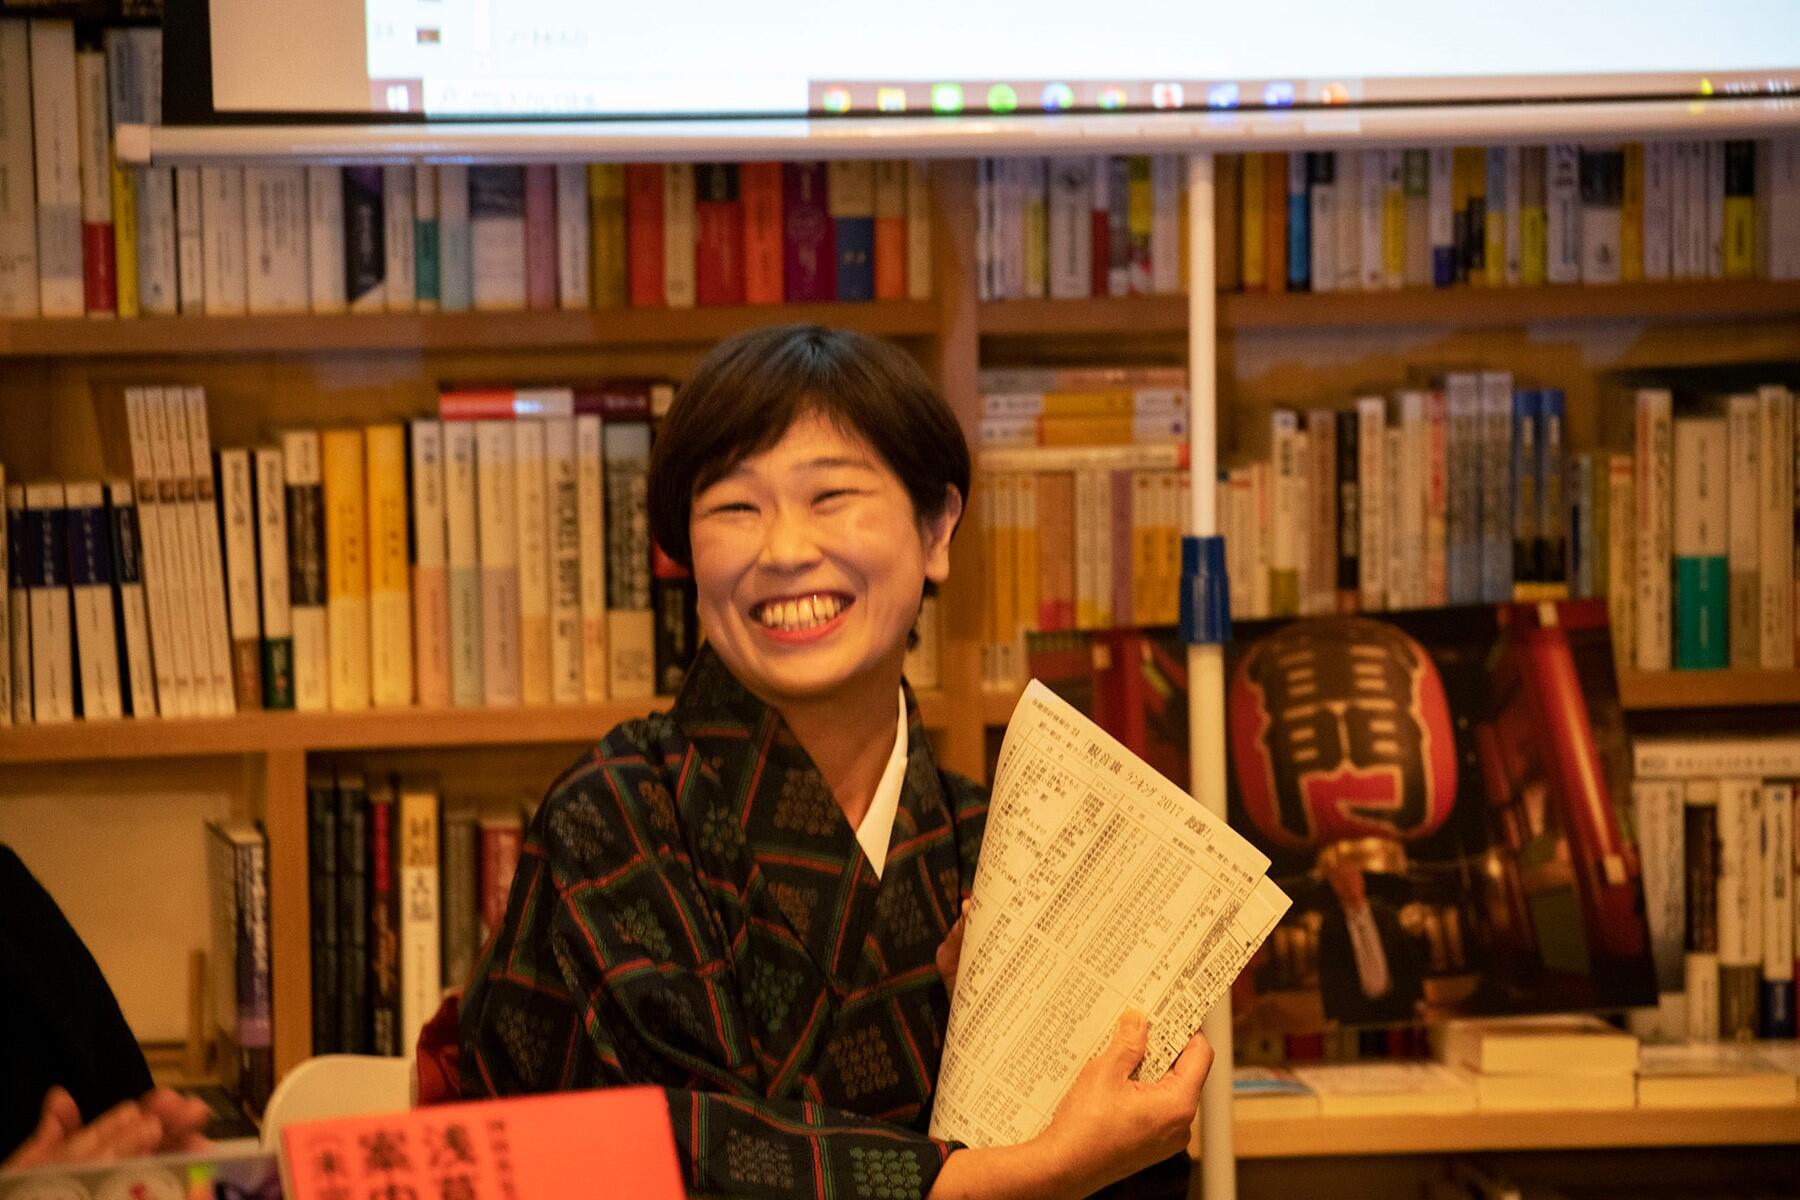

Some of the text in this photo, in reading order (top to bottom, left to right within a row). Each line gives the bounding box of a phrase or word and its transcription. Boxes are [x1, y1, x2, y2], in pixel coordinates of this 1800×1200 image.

[1123, 769, 1157, 799] ランキング
[1156, 794, 1184, 819] 2017
